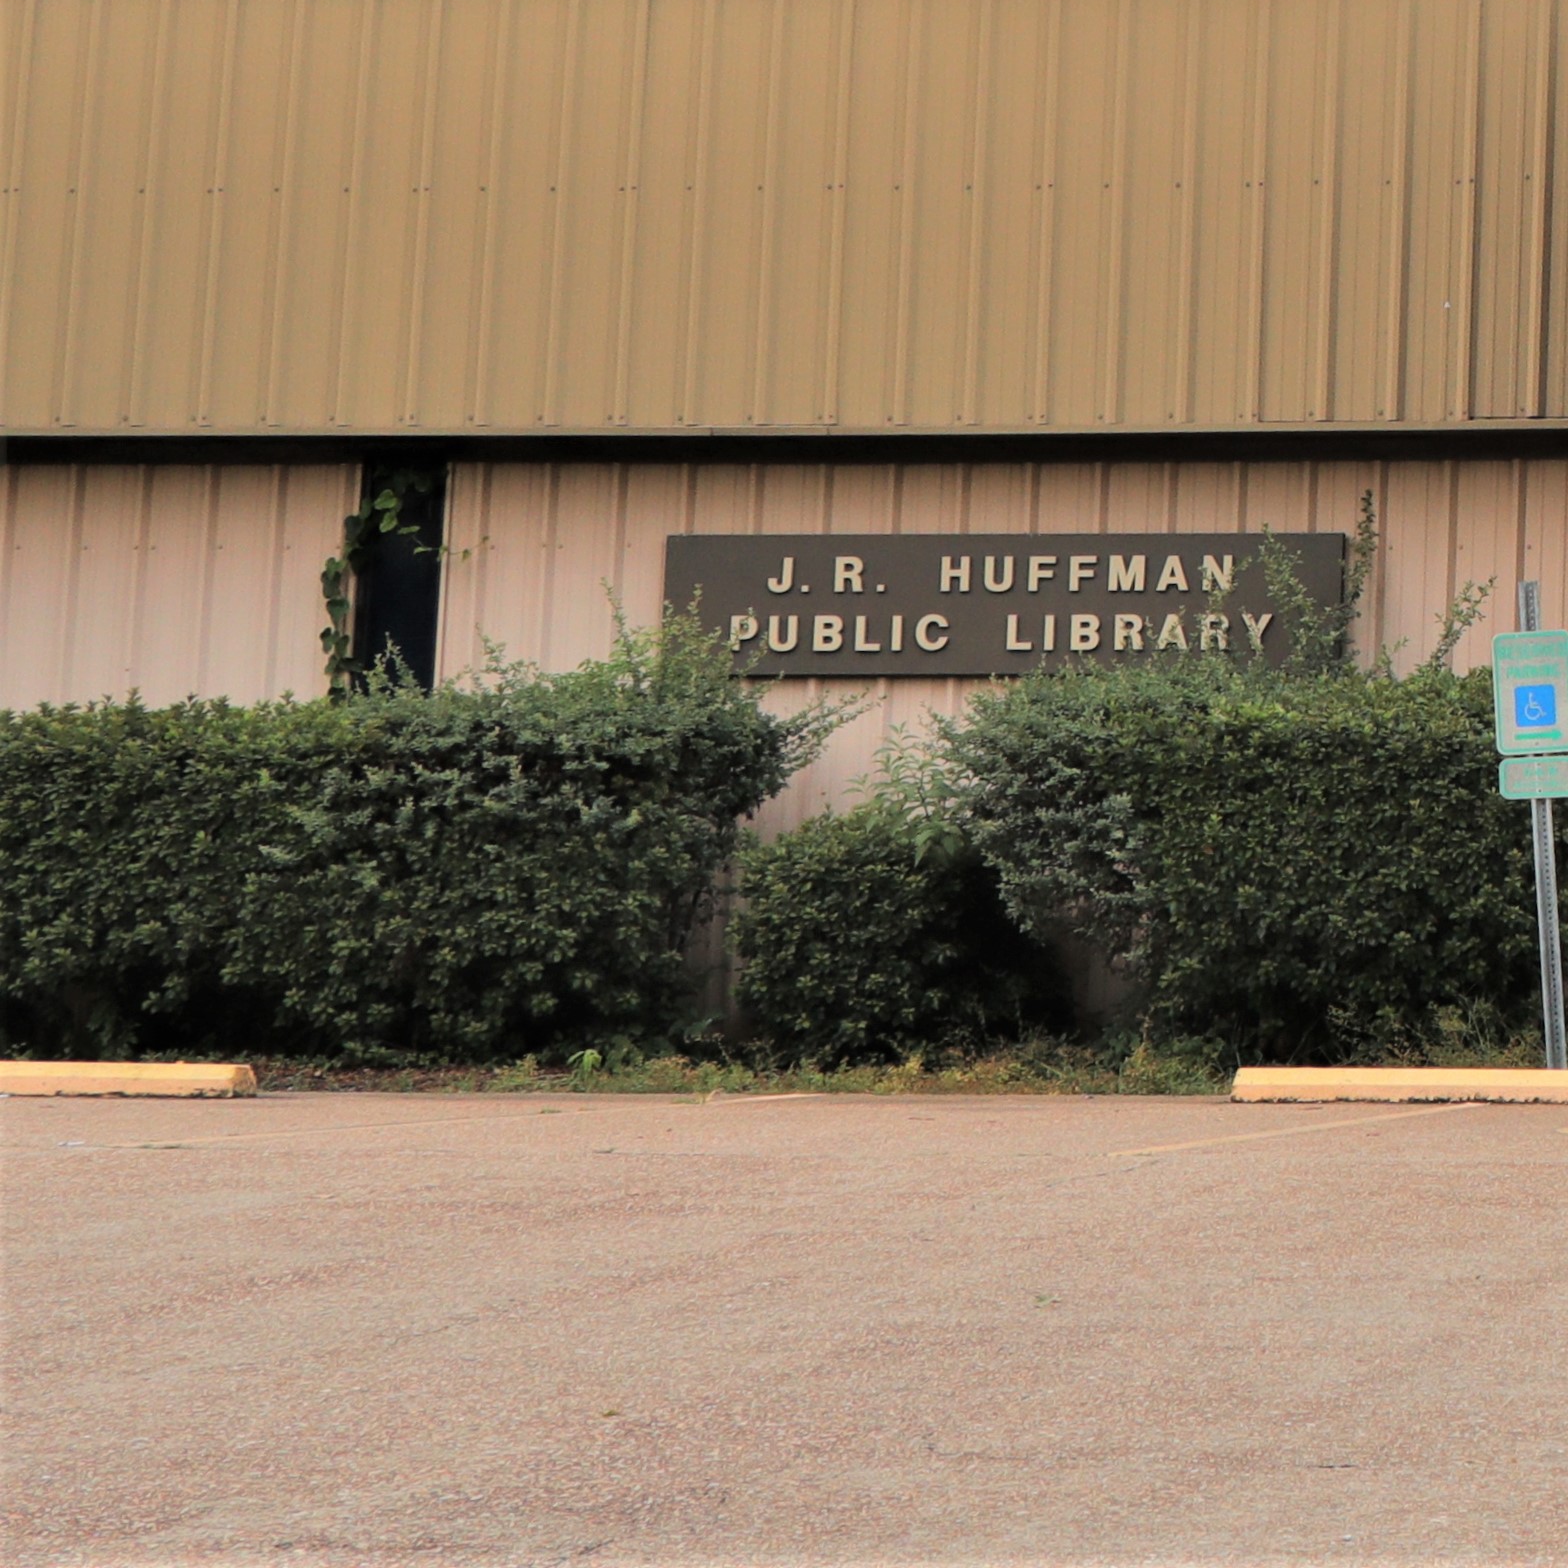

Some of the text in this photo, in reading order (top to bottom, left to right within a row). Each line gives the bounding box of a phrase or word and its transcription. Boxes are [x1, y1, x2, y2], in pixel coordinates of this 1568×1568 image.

[939, 554, 1234, 592] HUFFMAN
[730, 612, 1273, 652] PUBLIC LIBRARY
